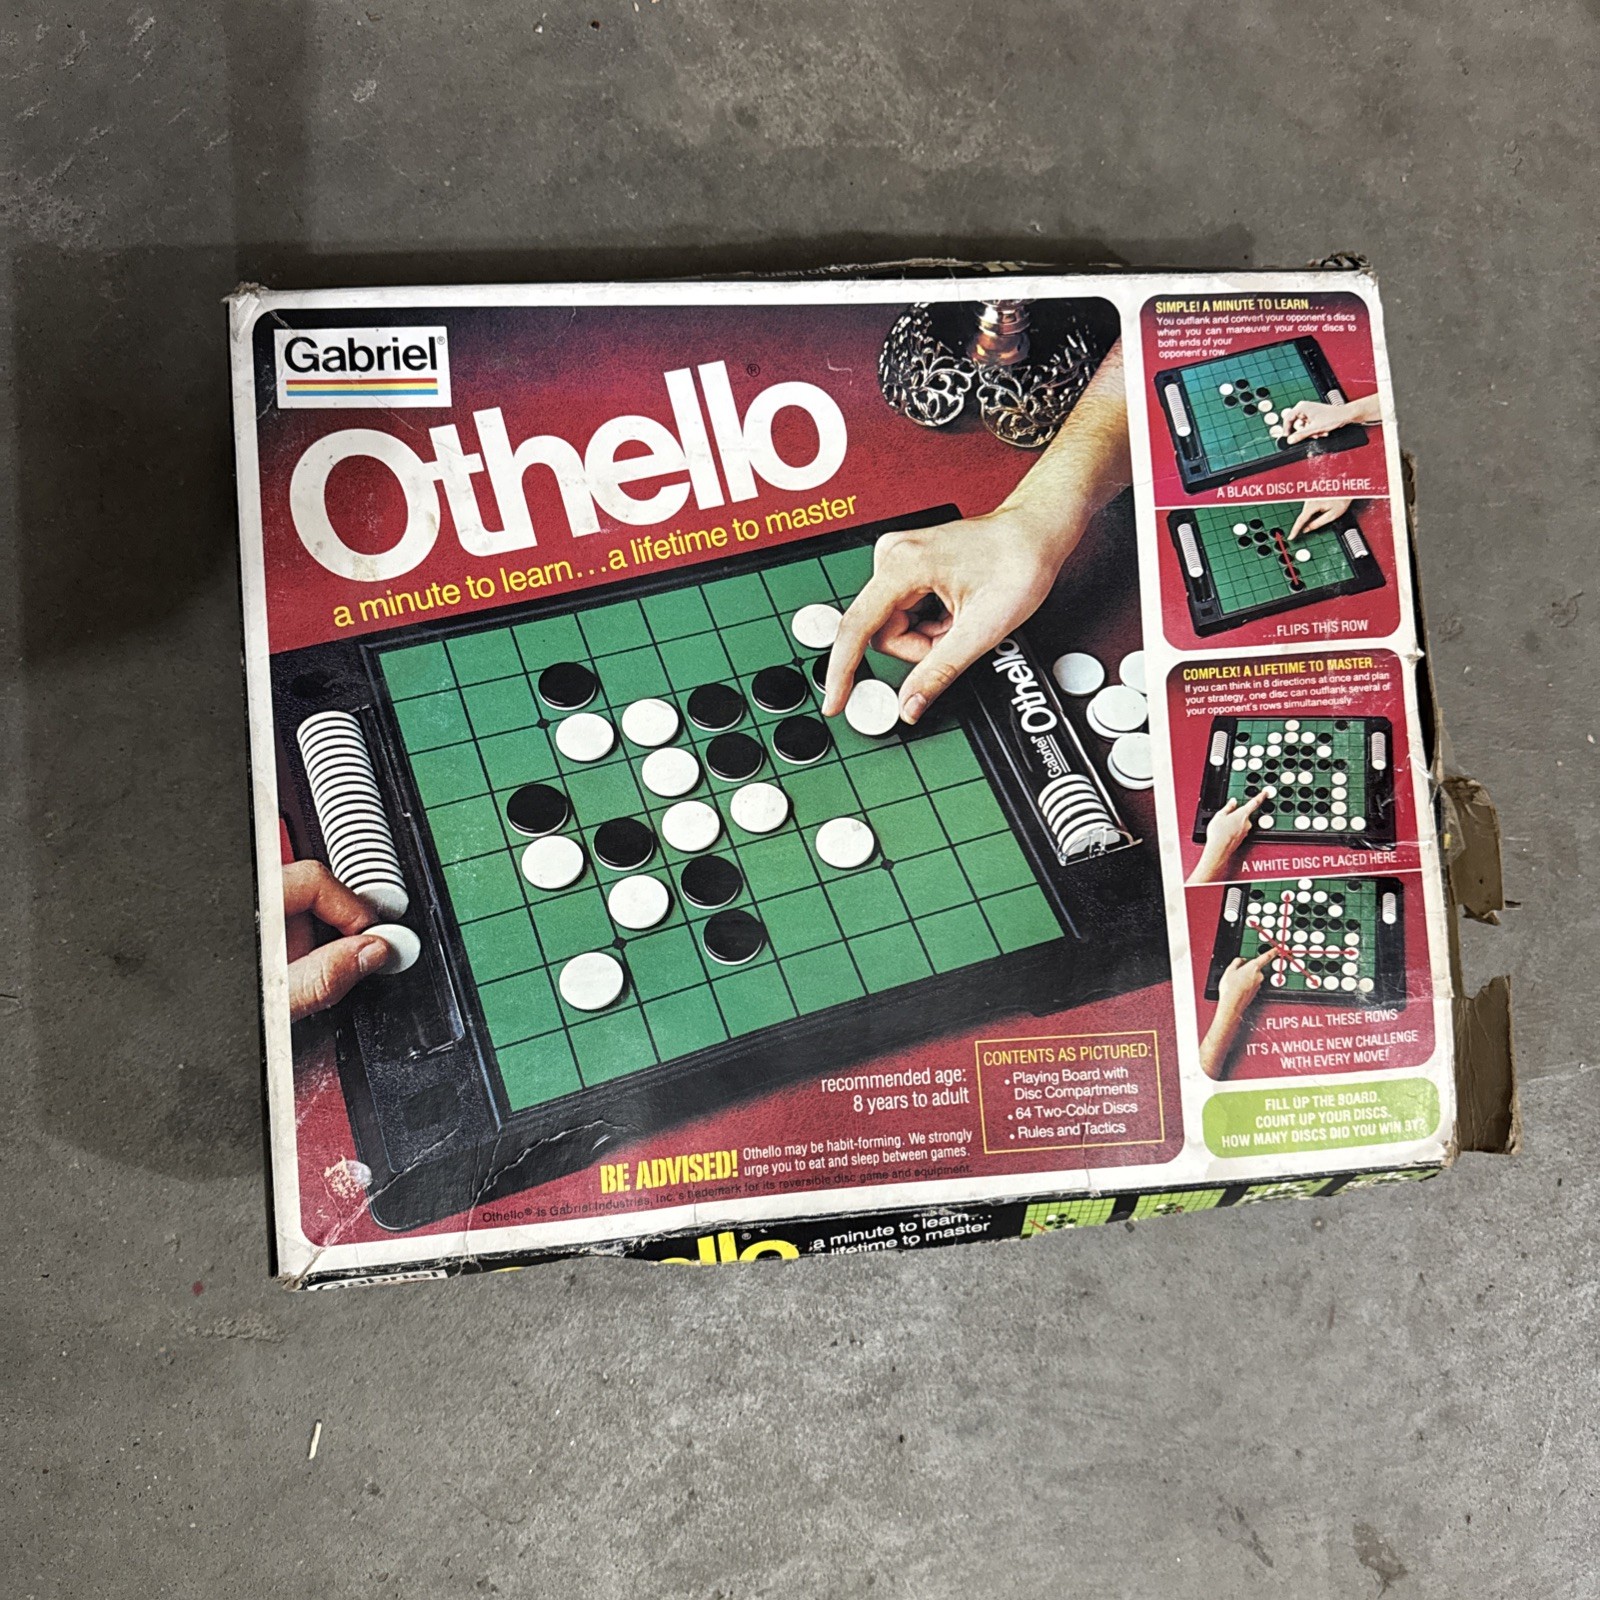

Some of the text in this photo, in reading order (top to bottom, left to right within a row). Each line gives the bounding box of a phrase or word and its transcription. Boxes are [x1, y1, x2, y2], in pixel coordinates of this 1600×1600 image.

[1156, 301, 1200, 314] SIMPLE!
[1203, 301, 1210, 312] A
[1213, 299, 1255, 312] MINUTE
[1258, 299, 1272, 310] TO
[1157, 313, 1356, 326] You outflank and convert your opponent's discs
[1157, 324, 1357, 338] when you can maneuver your color discs to
[1158, 338, 1233, 348] both ends of your
[1159, 349, 1207, 360] opponent's
[1217, 480, 1340, 499] A BLACK DISC PLACED
[333, 606, 355, 628] a
[359, 582, 461, 622] minute
[465, 575, 496, 600] to
[630, 527, 728, 566] lifetime
[732, 518, 760, 543] to
[766, 495, 858, 534] master
[1312, 620, 1339, 634] THIS
[1341, 620, 1368, 632] ROW
[1183, 666, 1241, 681] COMPLEX!
[1244, 665, 1252, 677] A
[1254, 662, 1306, 677] LIFETIME
[1308, 660, 1324, 672] TO
[992, 639, 1058, 734] Othello
[1186, 696, 1206, 706] your
[1269, 690, 1288, 699] disc
[1310, 686, 1347, 695] outflank
[1349, 684, 1380, 693] several
[1382, 682, 1392, 691] of
[1192, 672, 1390, 695] you can think in 8 directions at once and plan
[1186, 702, 1282, 717] your opponent's rows
[1030, 736, 1063, 779] Gabriel
[1242, 854, 1367, 873] A WHITE DISC PLACED
[1302, 1016, 1324, 1029] ALL
[1325, 1012, 1362, 1027] THESE
[1365, 1009, 1398, 1023] ROWS
[1247, 1030, 1419, 1056] IT'S A WHOLE NEW CHALLENGE
[984, 1043, 1152, 1066] CONTENTS AS PICTURED:
[1280, 1050, 1389, 1070] WITH EVERY MOVE!
[822, 1068, 967, 1093] recommended age:
[1013, 1067, 1128, 1087] Playing Board with
[854, 1087, 970, 1115] 8 years to adult
[1014, 1083, 1139, 1101] Disc Compartments
[1265, 1095, 1335, 1111] FILL UP THE
[1016, 1102, 1138, 1120] 64 Two-Color Discs
[1256, 1106, 1392, 1129] COUNT UP YOUR DISCS.
[1018, 1122, 1127, 1139] Rules and Tactics
[1221, 1134, 1250, 1148] HOW
[1254, 1131, 1287, 1146] MANY
[1291, 1128, 1327, 1143] DISCS
[1330, 1126, 1350, 1139] DID
[1352, 1124, 1376, 1138] YOU
[1379, 1121, 1402, 1135] WIN
[743, 1128, 972, 1161] Othello may be habit-forming. We strongly
[600, 1150, 739, 1194] BE ADVISED!
[744, 1146, 970, 1178] urge you to eat and sleep between games.
[550, 1201, 593, 1216] Gabriel
[745, 1181, 759, 1192] for
[763, 1180, 776, 1189] its
[779, 1174, 831, 1189] reversible
[834, 1172, 856, 1185] disc
[860, 1172, 889, 1184] game
[892, 1168, 912, 1178] and
[830, 1226, 895, 1246] minute
[899, 1222, 918, 1233] to
[902, 1234, 921, 1247] to
[925, 1222, 991, 1242] master
